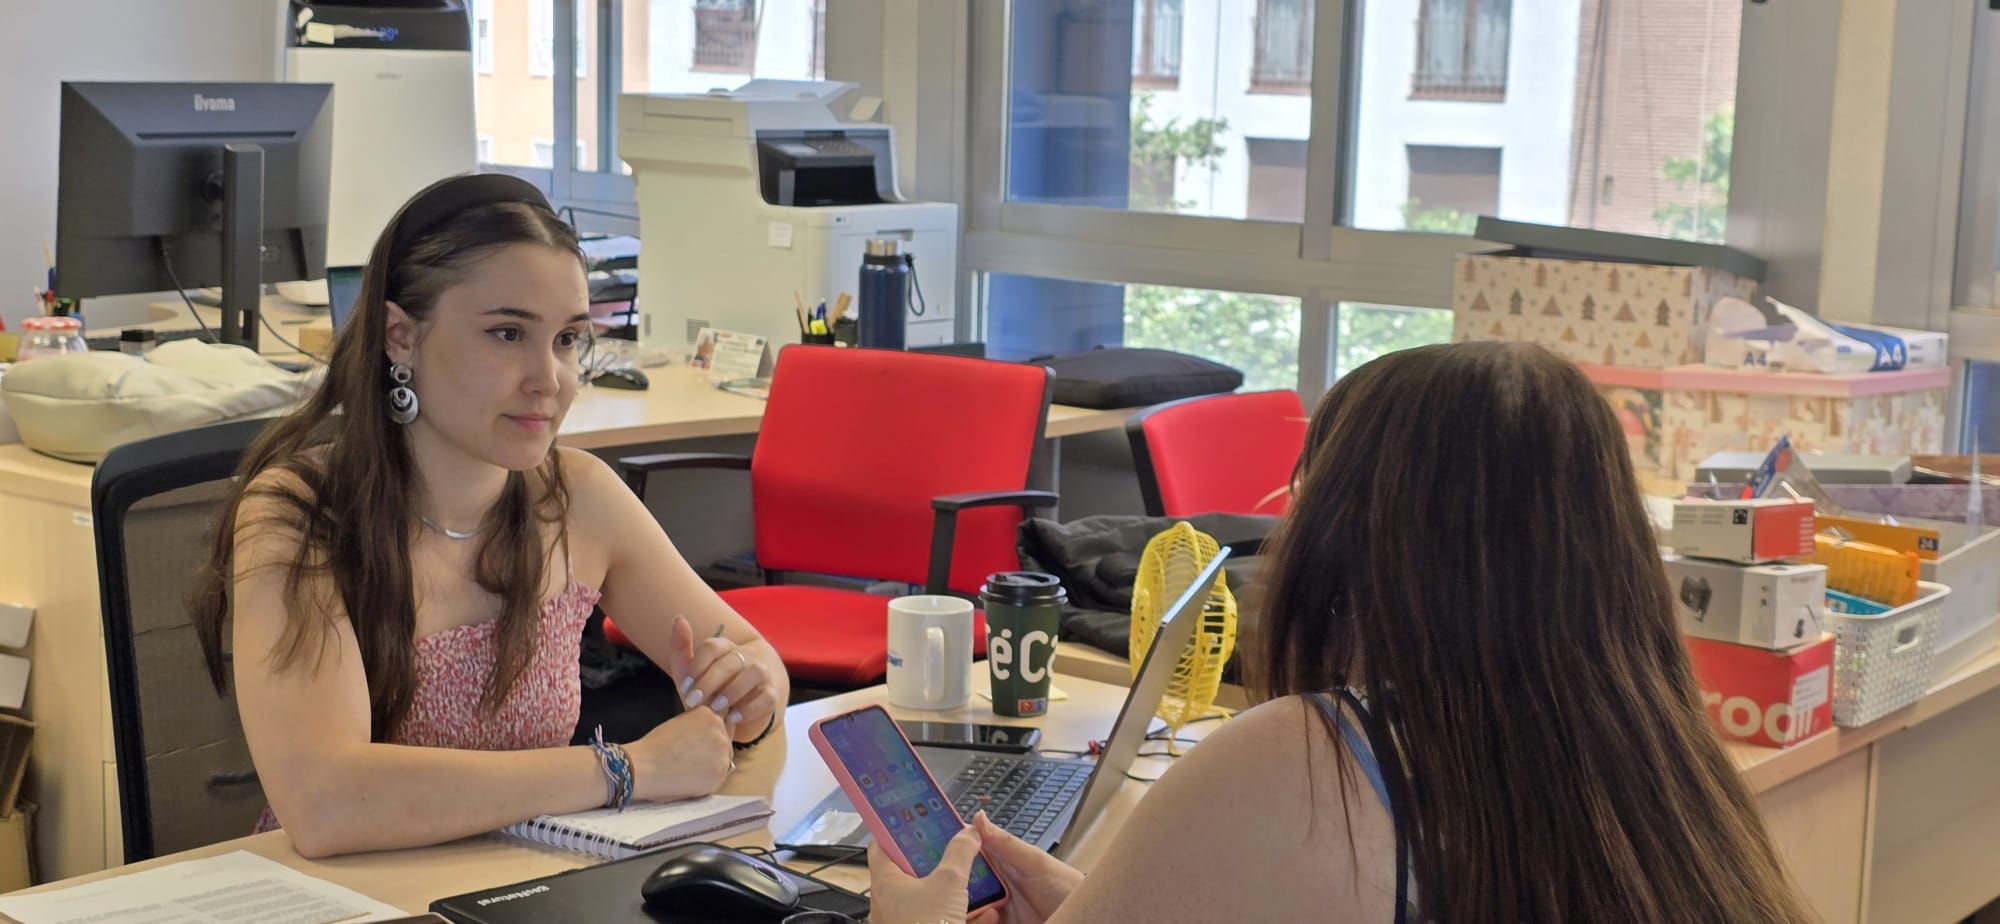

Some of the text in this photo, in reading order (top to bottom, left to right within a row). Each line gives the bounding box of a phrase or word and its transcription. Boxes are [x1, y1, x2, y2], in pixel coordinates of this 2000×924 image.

[194, 94, 236, 111] iiyama
[1744, 351, 1767, 367] A4
[1879, 344, 1904, 367] A4
[986, 623, 1013, 680] é
